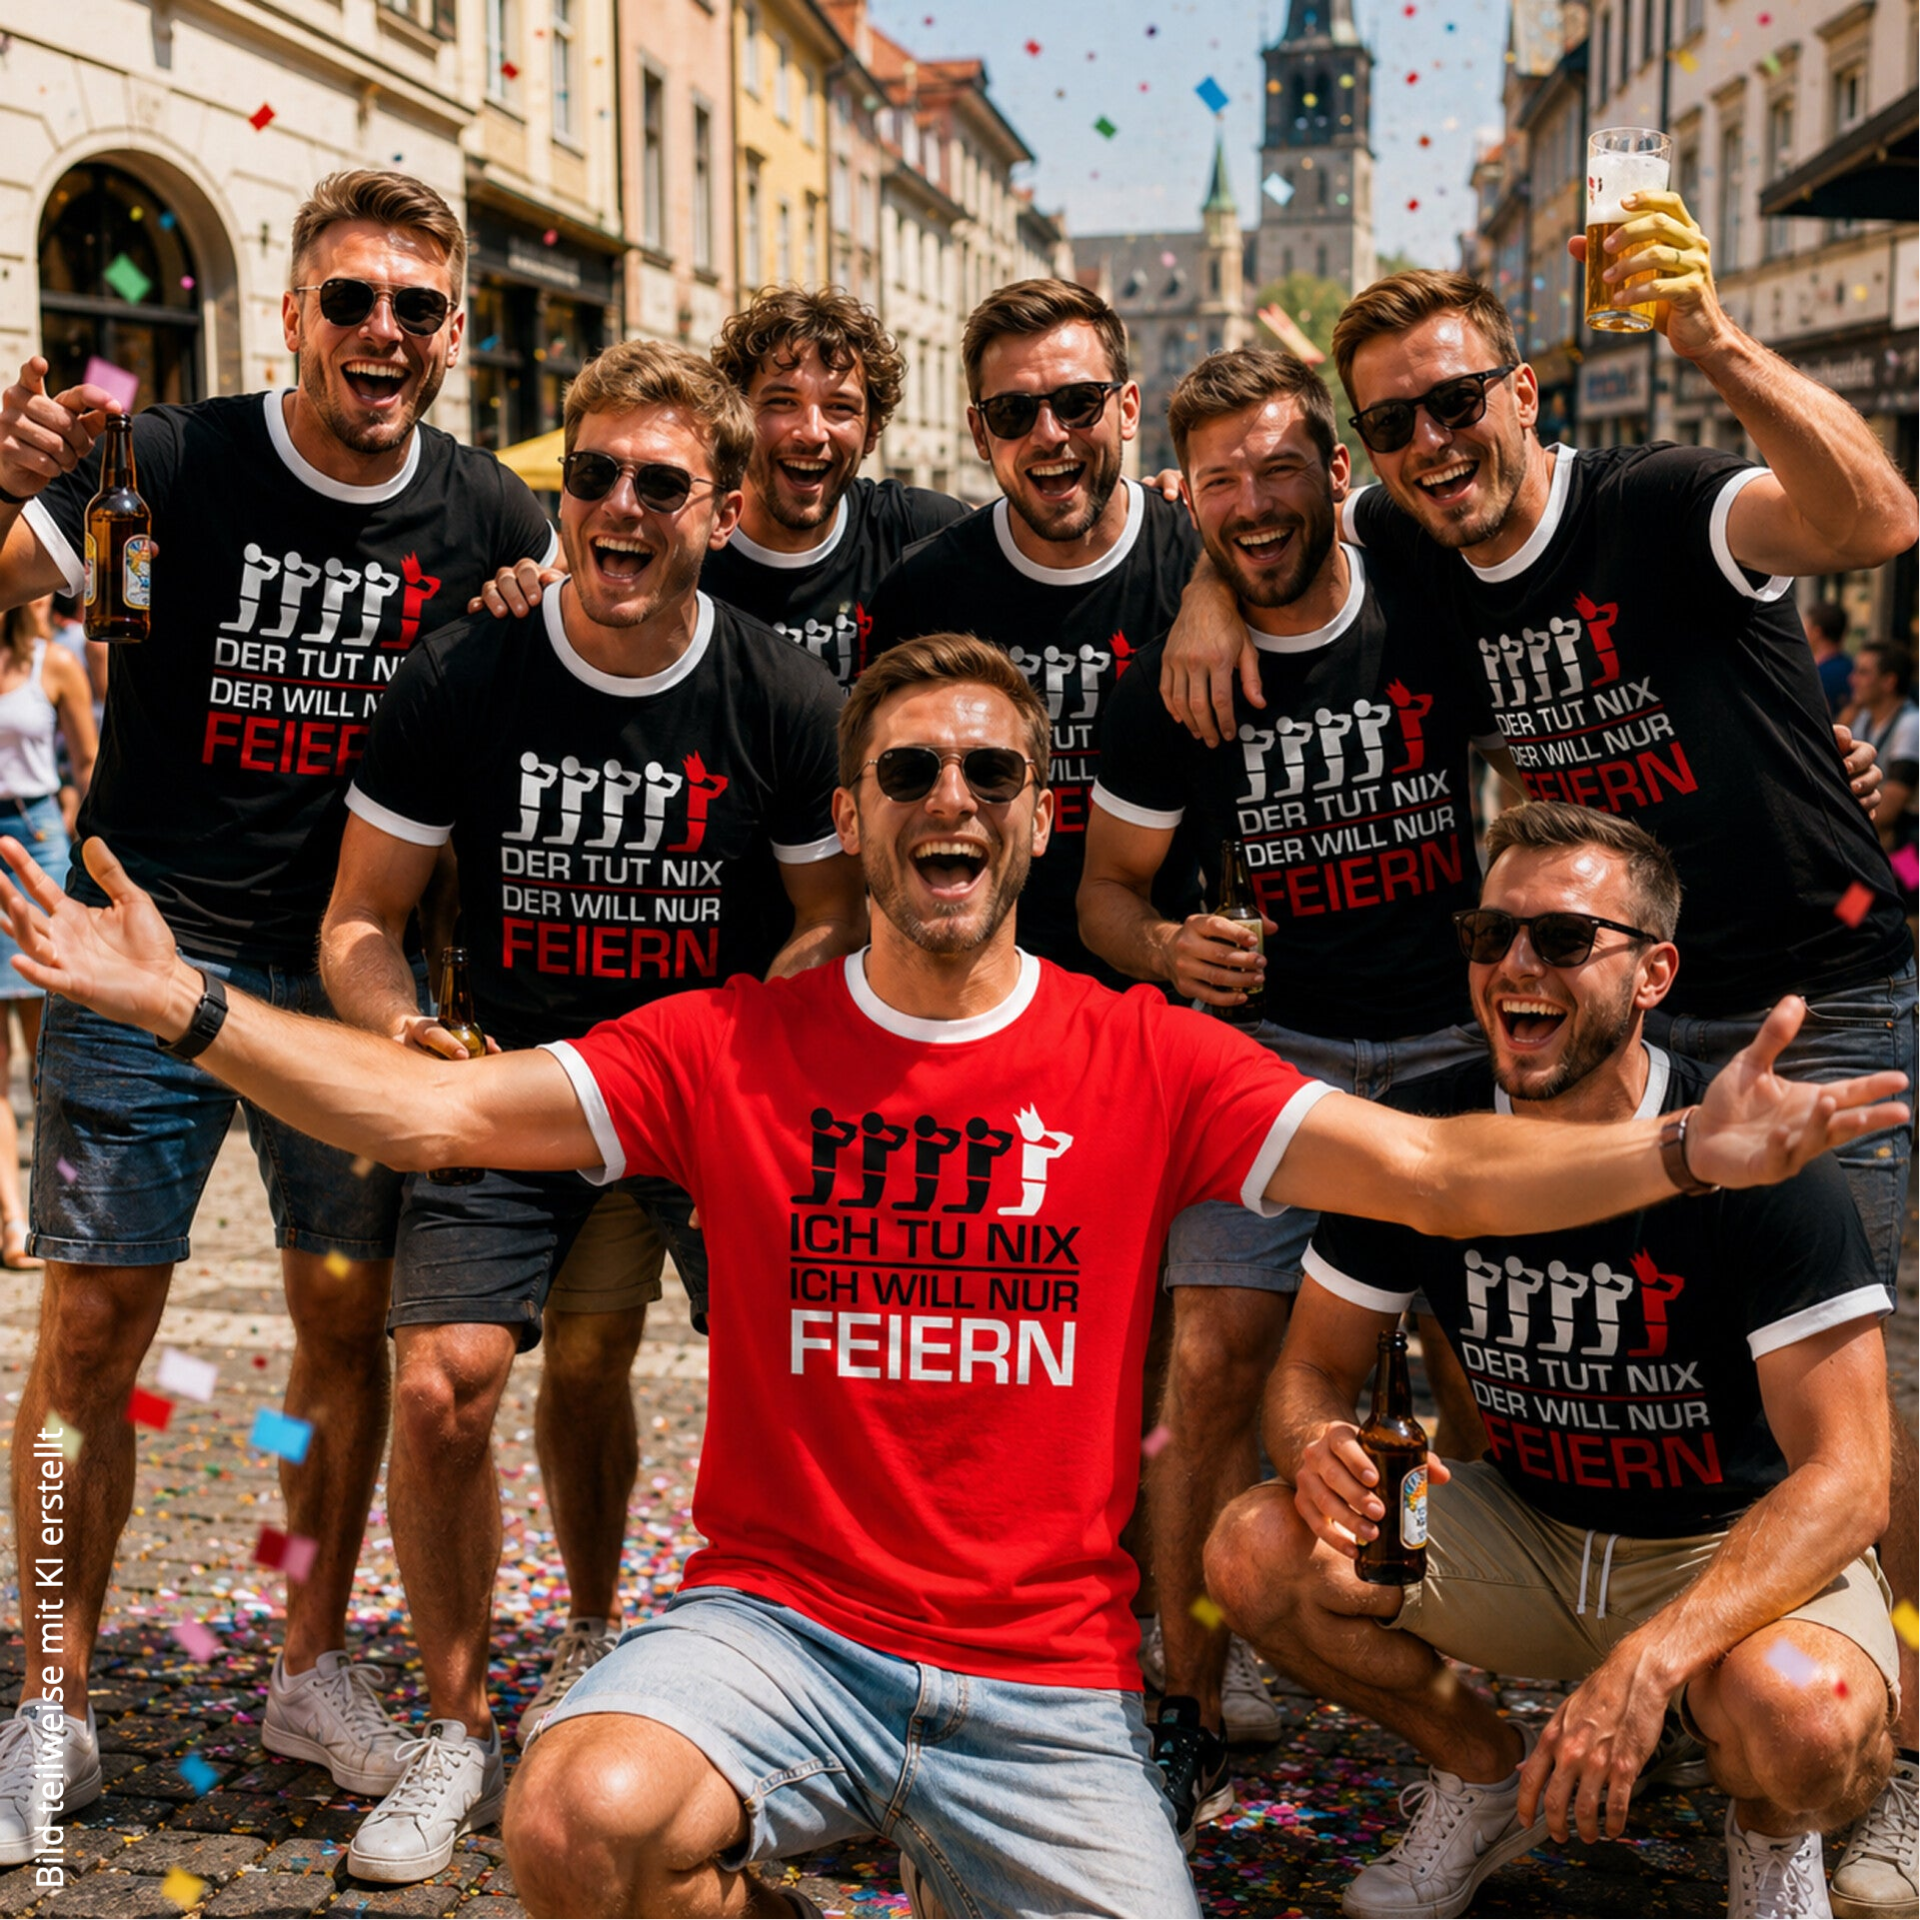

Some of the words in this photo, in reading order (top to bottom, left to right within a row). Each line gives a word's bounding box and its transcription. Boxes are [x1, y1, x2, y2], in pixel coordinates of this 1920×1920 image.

[214, 636, 287, 674] DER
[297, 648, 364, 680] TUT
[210, 676, 273, 711] DER
[282, 686, 354, 717] WILL
[1495, 711, 1537, 737] DER
[1536, 699, 1587, 733] TUT
[1593, 675, 1661, 720] NIX
[1049, 725, 1093, 749] UT
[1509, 743, 1542, 768] DER
[1541, 736, 1601, 766] WILL
[1603, 712, 1675, 755] NUR
[1237, 801, 1307, 835] DER
[1314, 785, 1381, 822] TUT
[1391, 769, 1451, 808] NIX
[1244, 837, 1306, 867] DER
[1310, 823, 1388, 857] WILL
[1393, 805, 1455, 843] NUR
[501, 846, 571, 880] DER
[581, 853, 651, 886] TUT
[661, 859, 724, 887] NIX
[1251, 833, 1464, 917] FEIERN
[502, 884, 562, 917] DER
[570, 892, 646, 922] WILL
[655, 897, 721, 923] NUR
[502, 916, 719, 979] FEIERN
[790, 1212, 879, 1256] ICH
[897, 1218, 966, 1260] TU
[987, 1223, 1082, 1265] NIX
[790, 1267, 859, 1304] ICH
[872, 1271, 975, 1310] WILL
[988, 1277, 1080, 1313] NUR
[791, 1308, 1077, 1387] FEIERN
[1461, 1341, 1530, 1383] DER
[1537, 1357, 1613, 1393] TUT
[1626, 1361, 1704, 1393] NIX
[1471, 1378, 1528, 1419] DER
[1533, 1395, 1620, 1431] WILL
[1627, 1400, 1711, 1431] NUR
[1481, 1409, 1724, 1490] FEIERN
